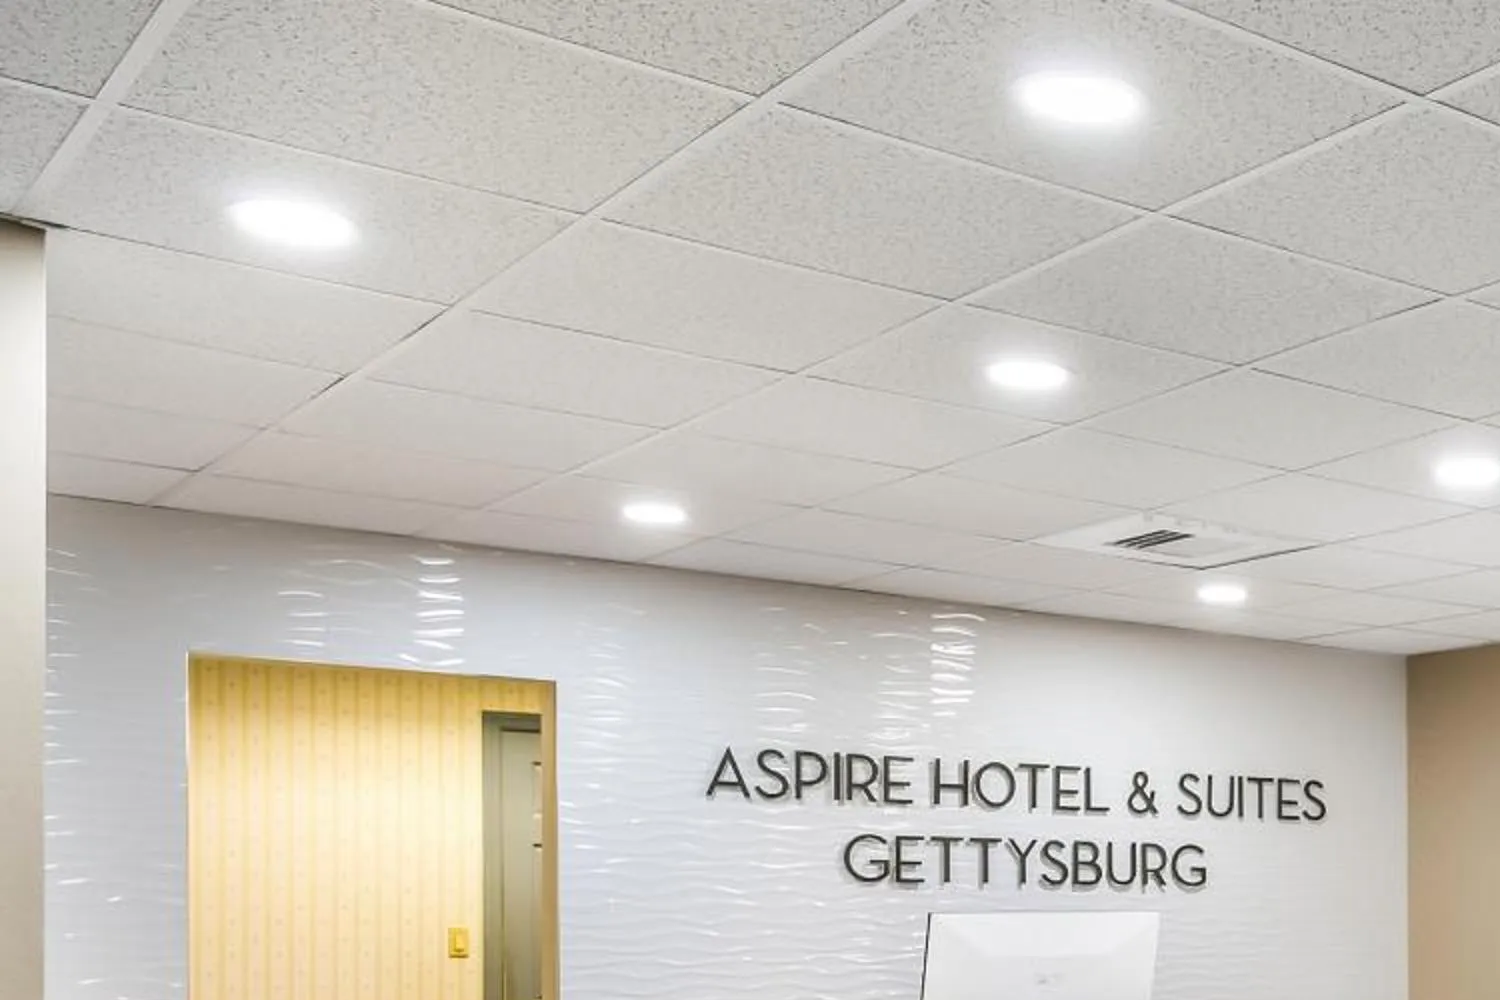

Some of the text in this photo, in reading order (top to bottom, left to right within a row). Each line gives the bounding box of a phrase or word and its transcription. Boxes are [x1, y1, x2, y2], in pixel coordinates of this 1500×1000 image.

[706, 747, 1326, 821] ASPIRE HOTEL & SUITES
[844, 834, 1206, 888] GETTYSBURG
